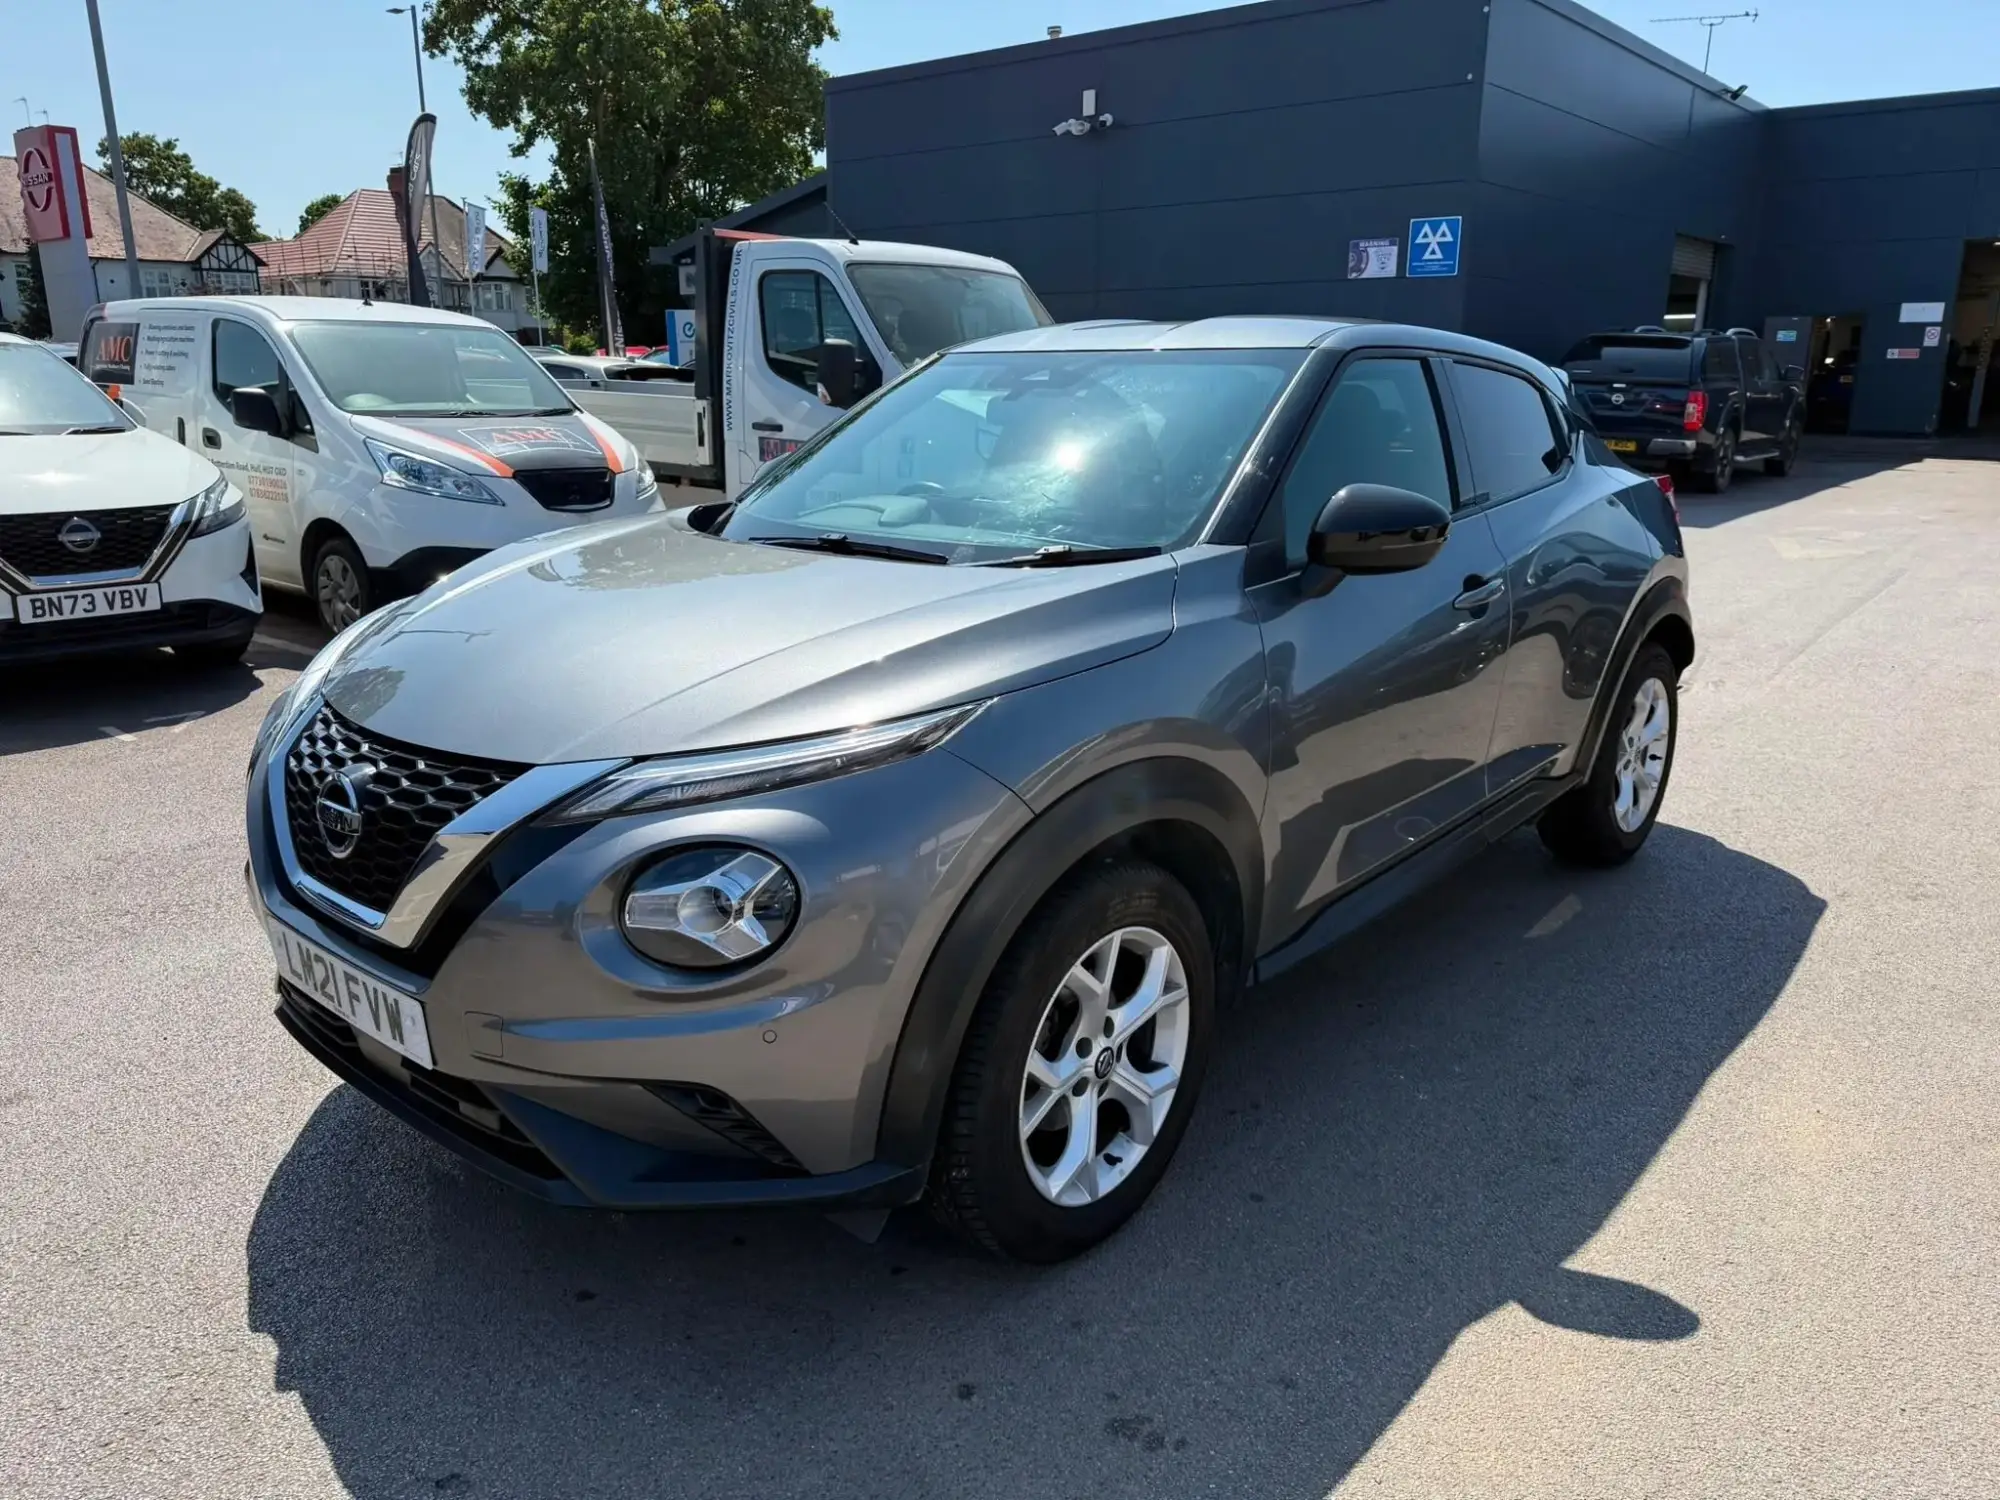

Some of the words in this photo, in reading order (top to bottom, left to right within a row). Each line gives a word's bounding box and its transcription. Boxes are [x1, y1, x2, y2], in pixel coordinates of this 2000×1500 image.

[409, 152, 421, 181] Cars
[96, 335, 133, 362] AMC
[30, 593, 97, 619] BN73
[103, 587, 148, 611] VBV
[282, 931, 343, 1009] LM21
[343, 969, 405, 1046] FVW
